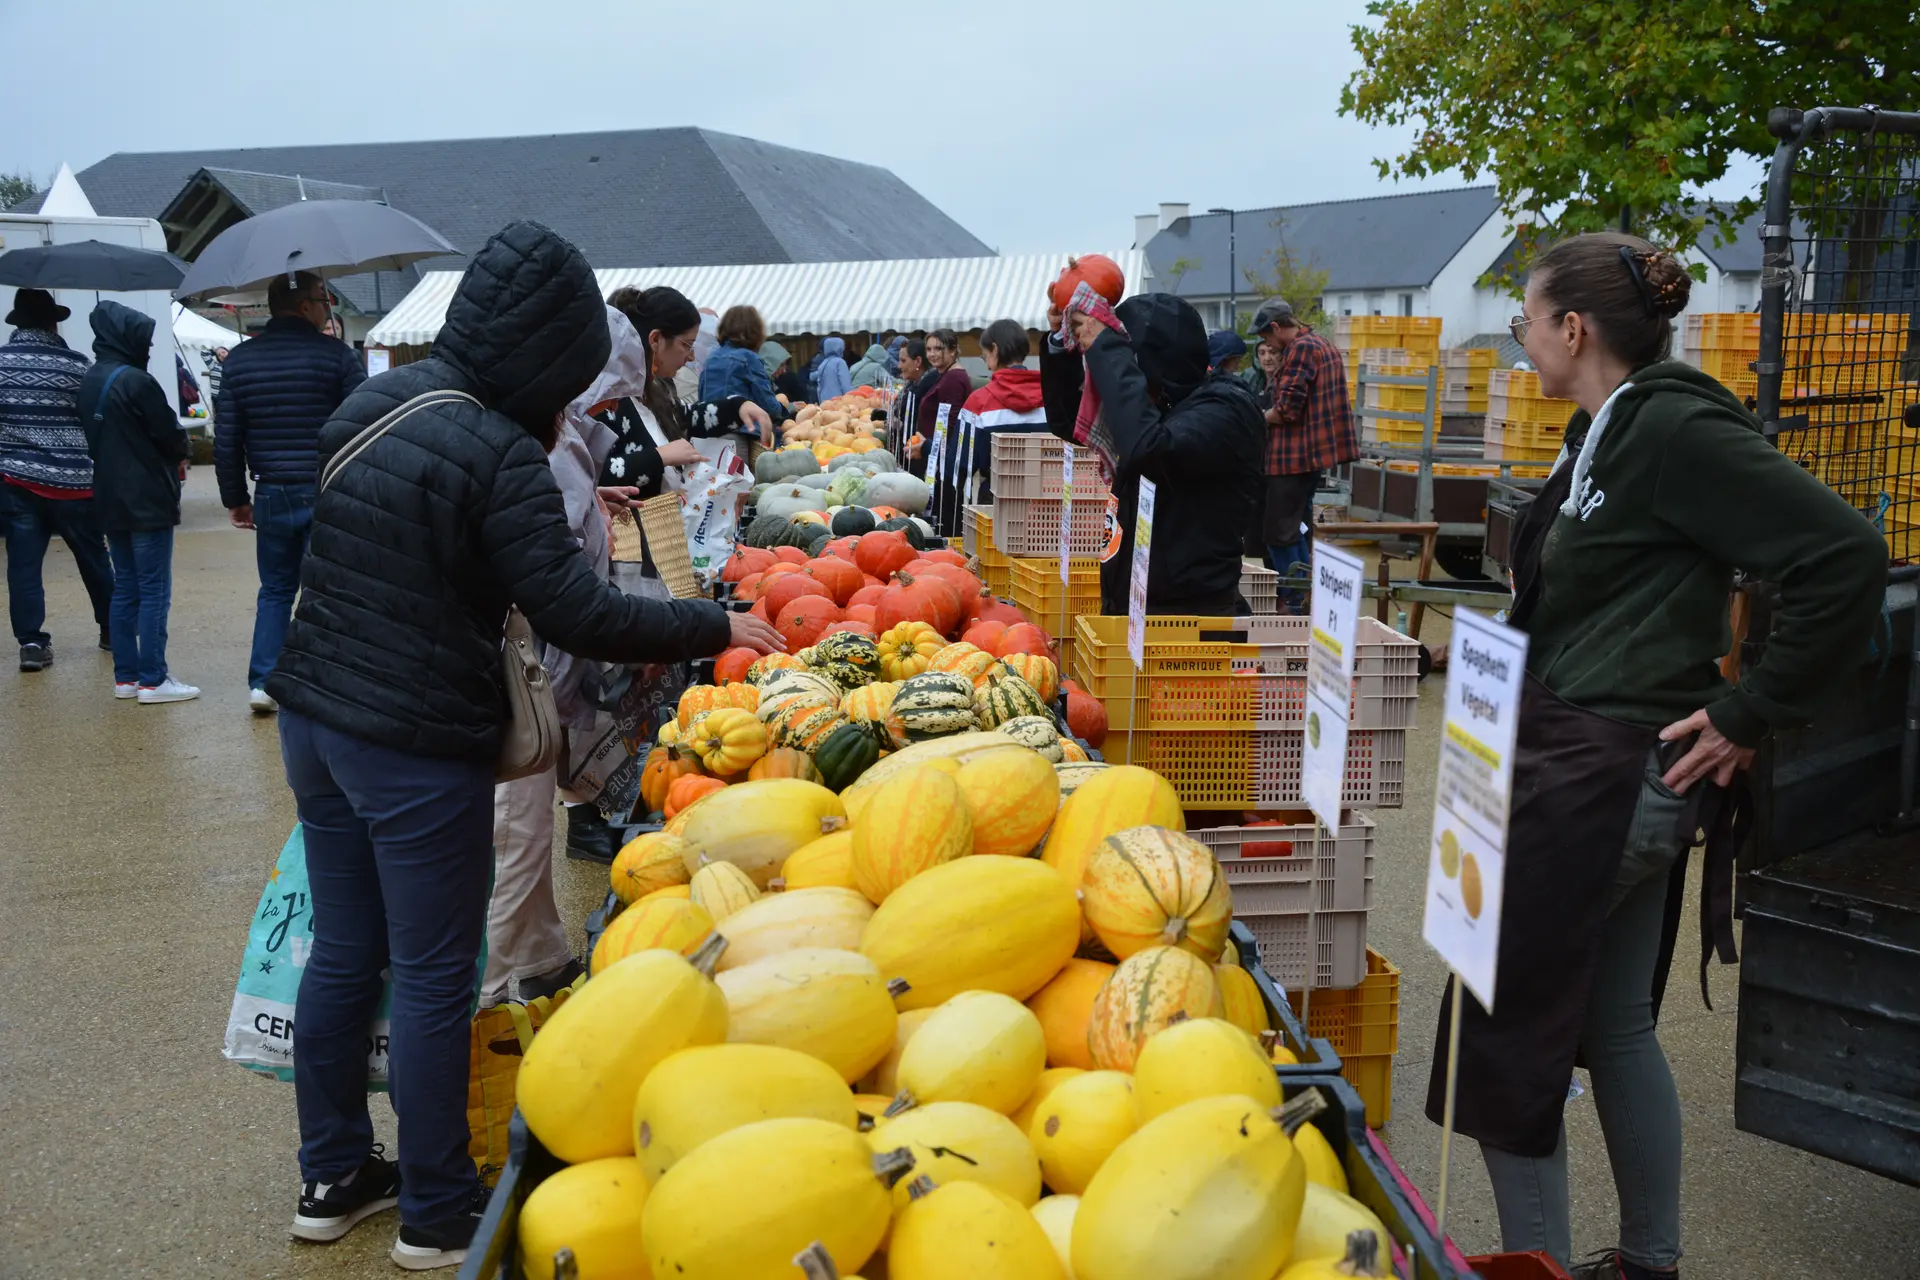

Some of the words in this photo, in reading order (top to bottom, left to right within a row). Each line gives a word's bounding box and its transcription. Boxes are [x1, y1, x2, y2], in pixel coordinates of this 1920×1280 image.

[1044, 450, 1090, 459] ARMOQUE
[1319, 565, 1354, 601] Stripetti
[1328, 610, 1338, 632] F1
[1158, 661, 1223, 671] ARMORIQUE
[1461, 638, 1511, 683] Spaghetti
